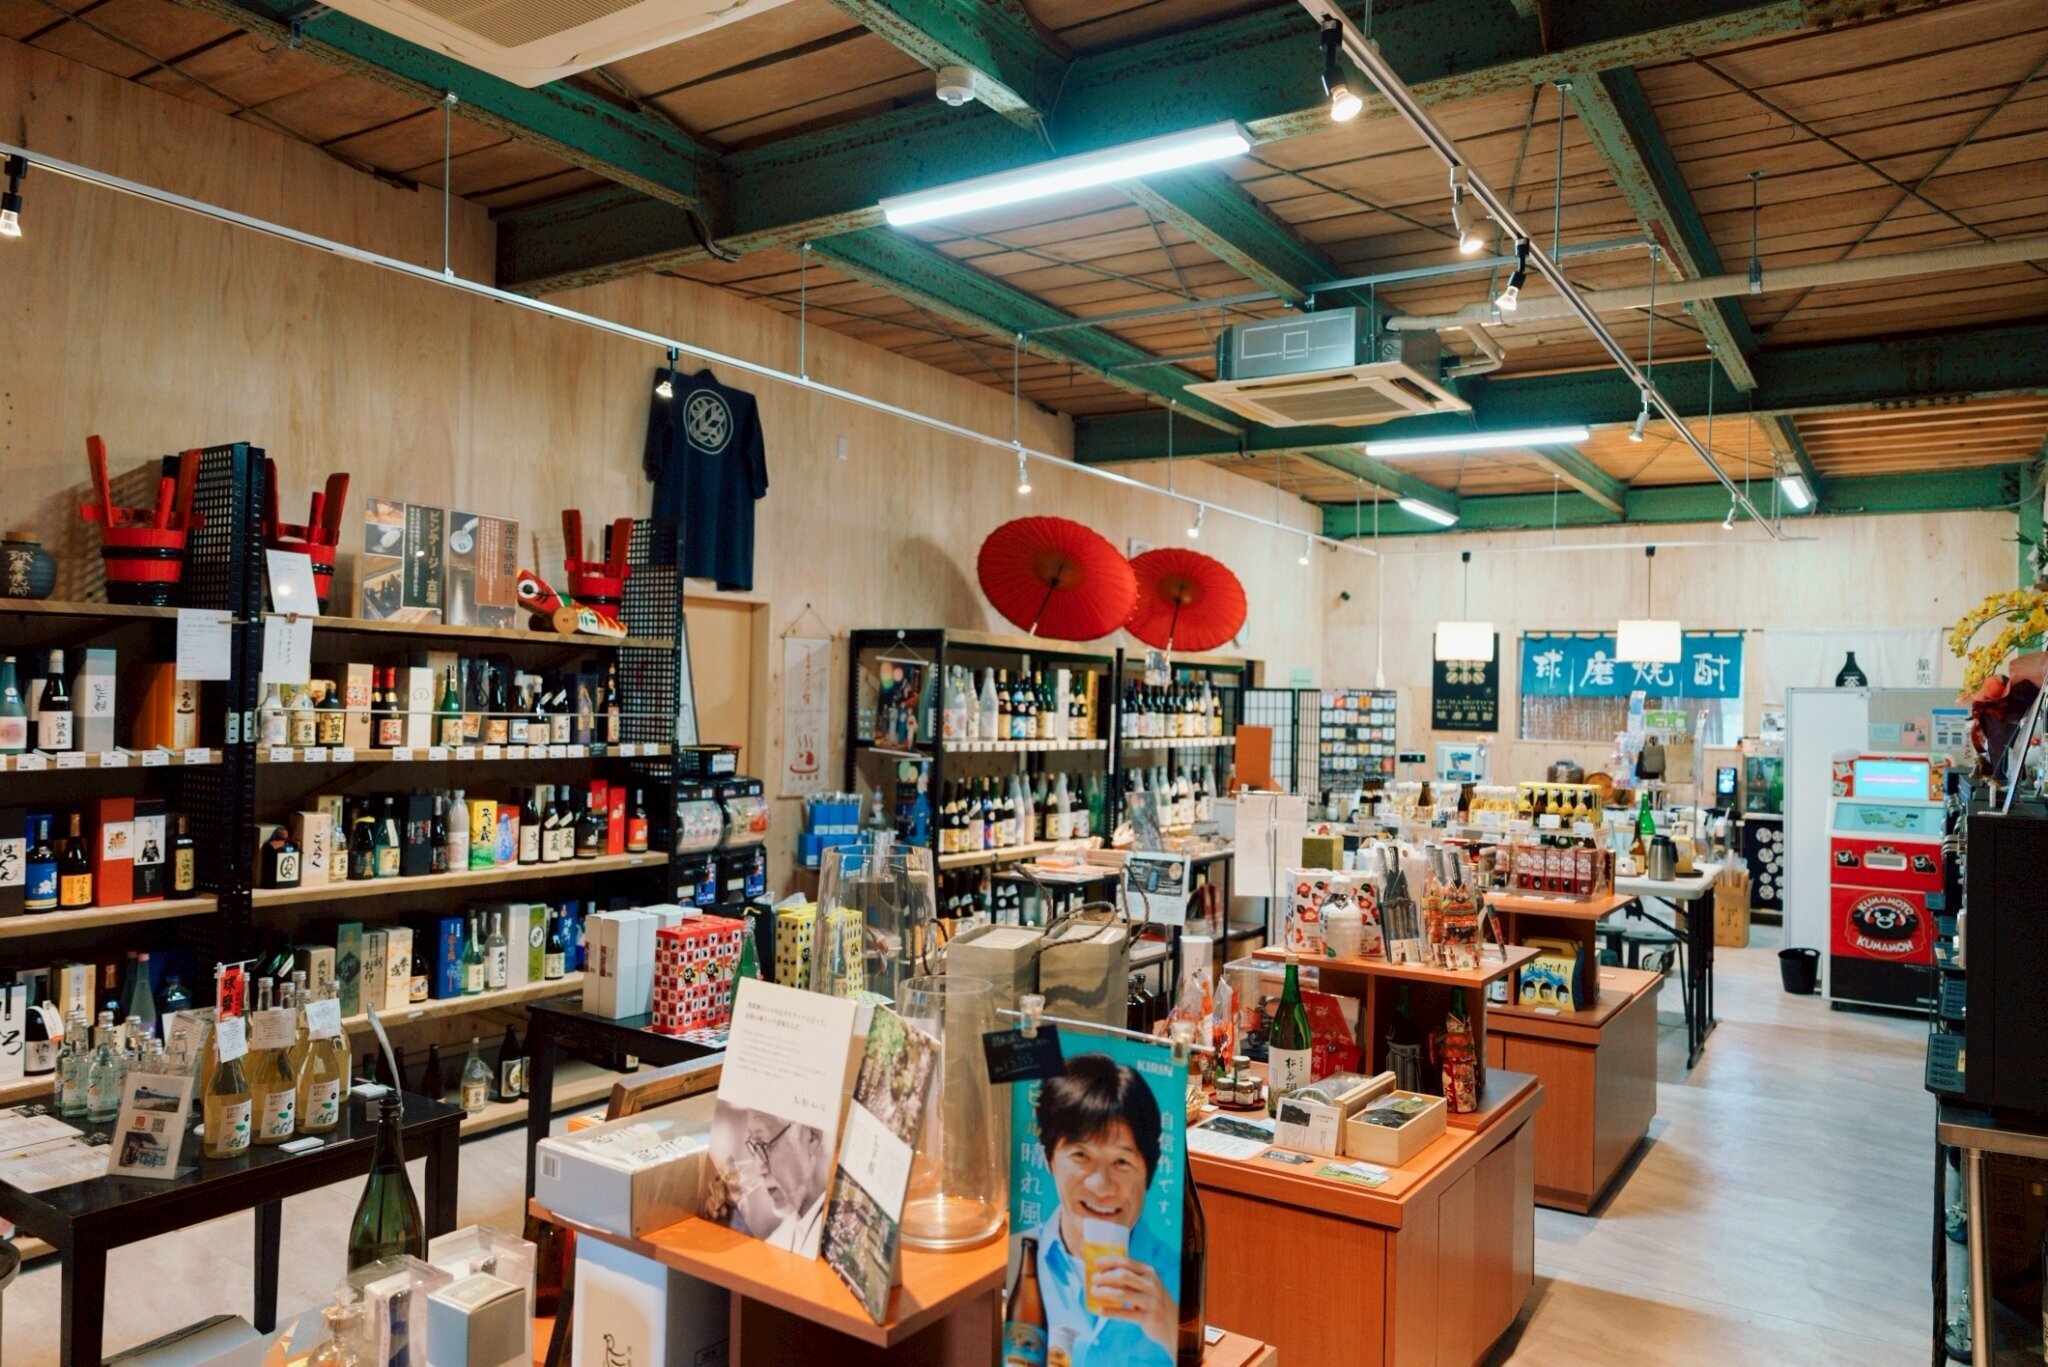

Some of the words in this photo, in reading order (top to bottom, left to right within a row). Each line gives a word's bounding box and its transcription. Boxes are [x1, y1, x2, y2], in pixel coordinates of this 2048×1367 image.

[1857, 896, 1915, 915] KUMAMOTO
[1856, 936, 1914, 952] KUMAMON
[1136, 1059, 1174, 1078] KIRIN
[1157, 1110, 1175, 1226] 自信作です。
